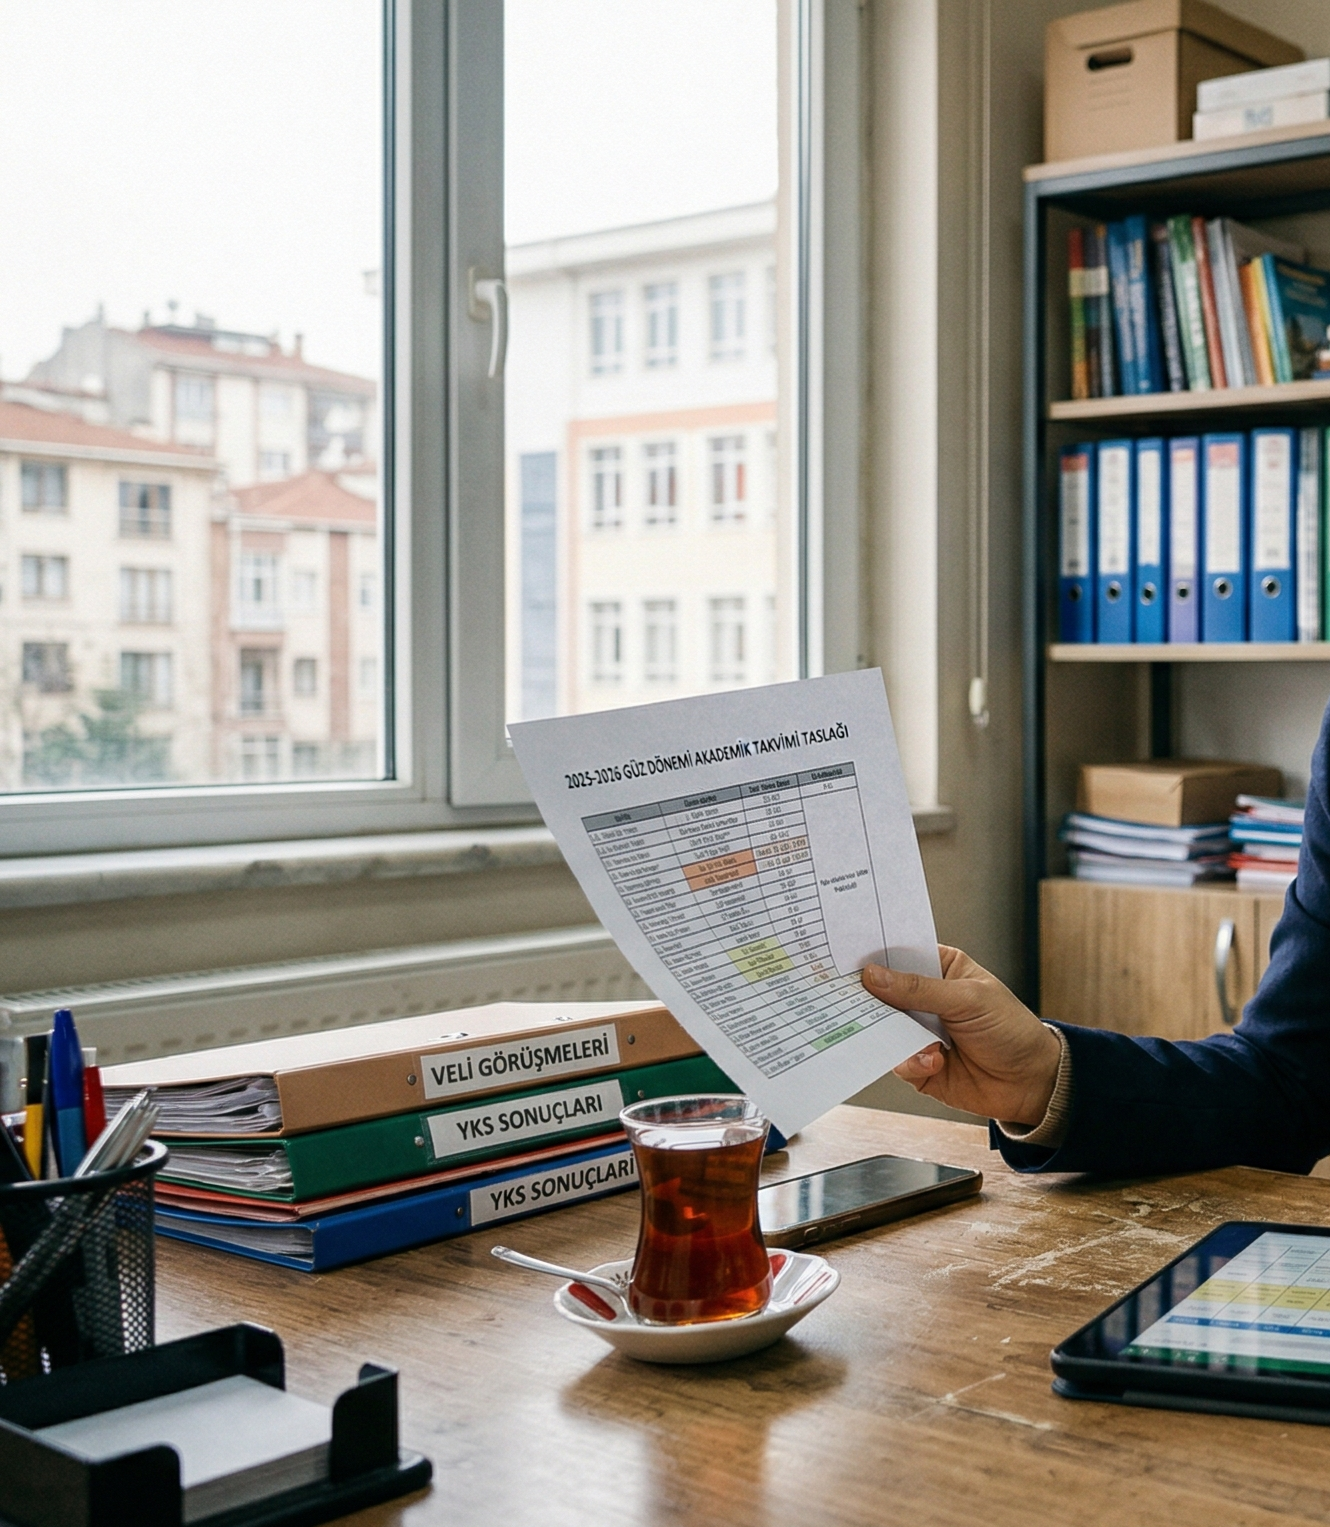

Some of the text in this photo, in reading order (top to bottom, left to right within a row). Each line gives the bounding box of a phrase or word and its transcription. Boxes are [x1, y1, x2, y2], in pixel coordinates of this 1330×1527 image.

[622, 759, 648, 780] GÜZ
[646, 749, 693, 775] DÖNEMİ
[694, 740, 752, 767] AKADEMİK
[752, 730, 801, 755] TAKVİMİ
[801, 721, 850, 746] TASLAĞI
[430, 1032, 610, 1086] VELİ GÖRÜŞMELERİ
[456, 1094, 603, 1141] YKS SONUÇLARI
[490, 1153, 635, 1211] YKS SONUÇLARİ
